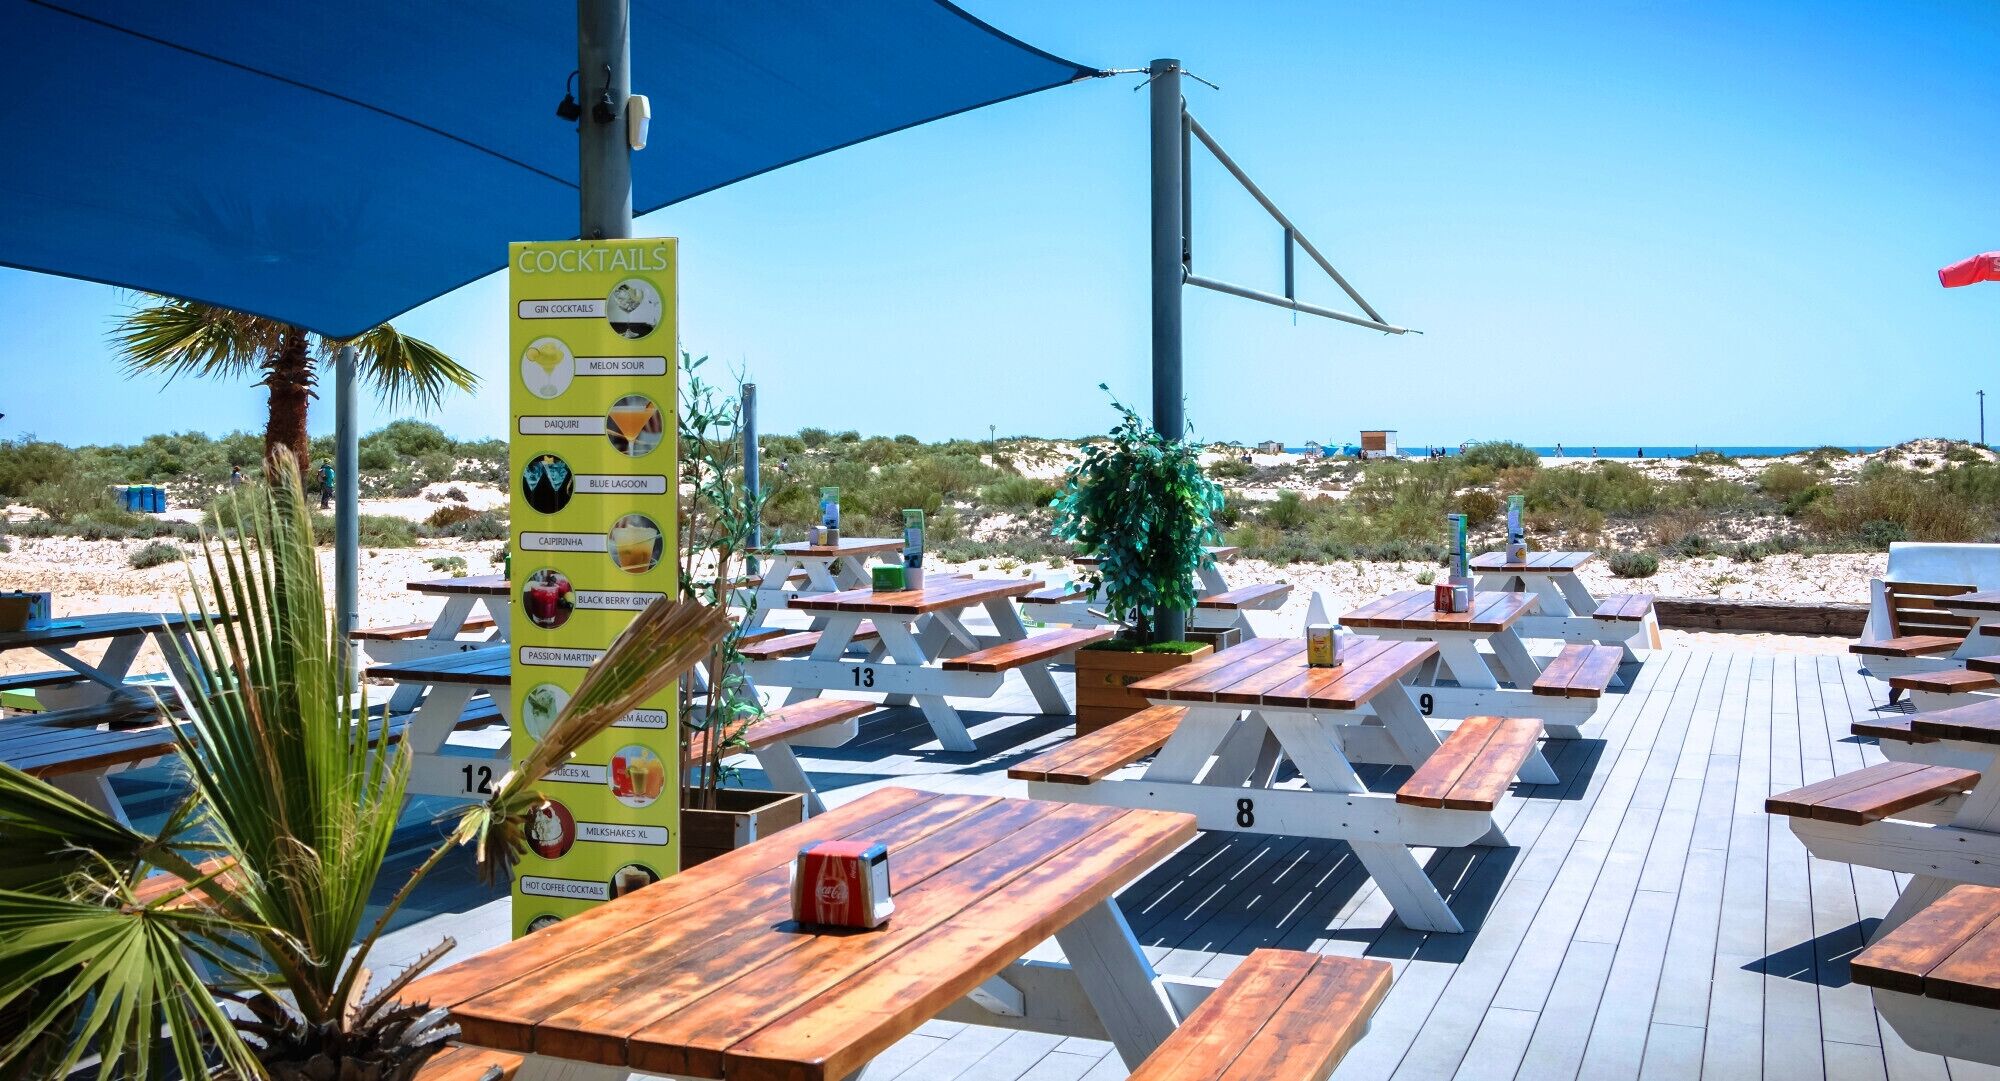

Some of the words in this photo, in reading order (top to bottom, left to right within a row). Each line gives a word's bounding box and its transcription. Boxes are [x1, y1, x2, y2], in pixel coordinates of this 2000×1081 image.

[518, 248, 667, 273] COCKTAILS
[534, 305, 549, 313] GIN
[551, 304, 594, 313] COCKTAILS
[589, 362, 619, 370] MELON
[621, 361, 645, 370] SOUR
[544, 420, 579, 429] DAIQUIRI
[589, 480, 610, 488] BLUE
[611, 480, 648, 488] LAGOON
[538, 534, 583, 545] CAIPIRINHA
[578, 595, 603, 604] BLACK
[605, 596, 631, 605] BERRY
[1129, 607, 1138, 621] 4
[528, 652, 562, 661] PASSION
[852, 667, 874, 687] 13
[1420, 693, 1434, 715] 9
[635, 712, 665, 723] ÁLCOOL
[462, 764, 492, 794] 12
[580, 769, 591, 778] XL
[1237, 798, 1255, 828] 8
[586, 827, 636, 838] MILKSHAKES
[637, 830, 648, 839] XL
[525, 881, 540, 890] HOT
[541, 882, 566, 893] COFFEE
[566, 885, 604, 895] COCKTAILS
